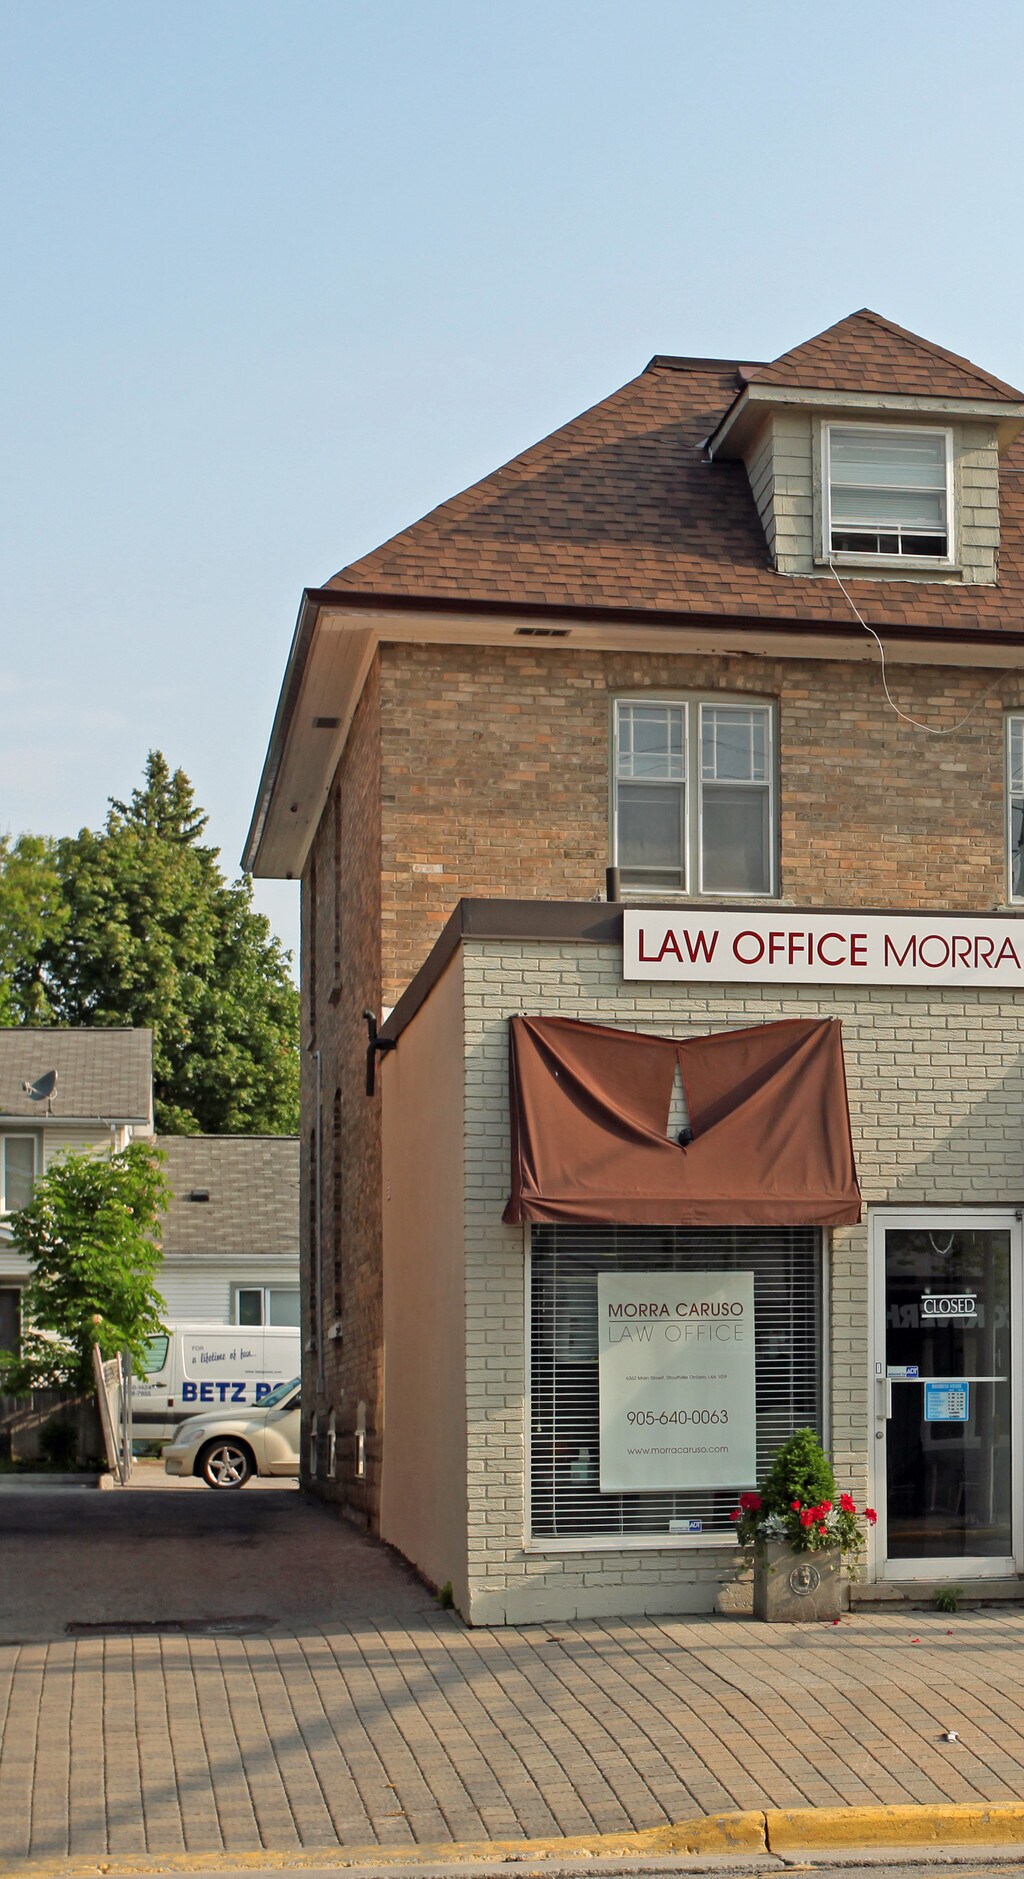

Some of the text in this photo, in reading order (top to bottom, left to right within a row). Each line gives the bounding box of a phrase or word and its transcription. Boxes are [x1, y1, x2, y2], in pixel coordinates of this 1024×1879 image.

[638, 928, 719, 964] LAW
[732, 930, 868, 967] OFFICE
[884, 934, 1021, 969] MORRA
[608, 1302, 744, 1317] MORRA CARUSO
[923, 1298, 975, 1313] CLOSED
[609, 1324, 743, 1342] LAW OFFICE
[906, 1367, 918, 1375] ADT
[182, 1382, 246, 1402] BETZ
[626, 1409, 729, 1425] 905-640-0063
[627, 1446, 729, 1454] www.morracaruso.com
